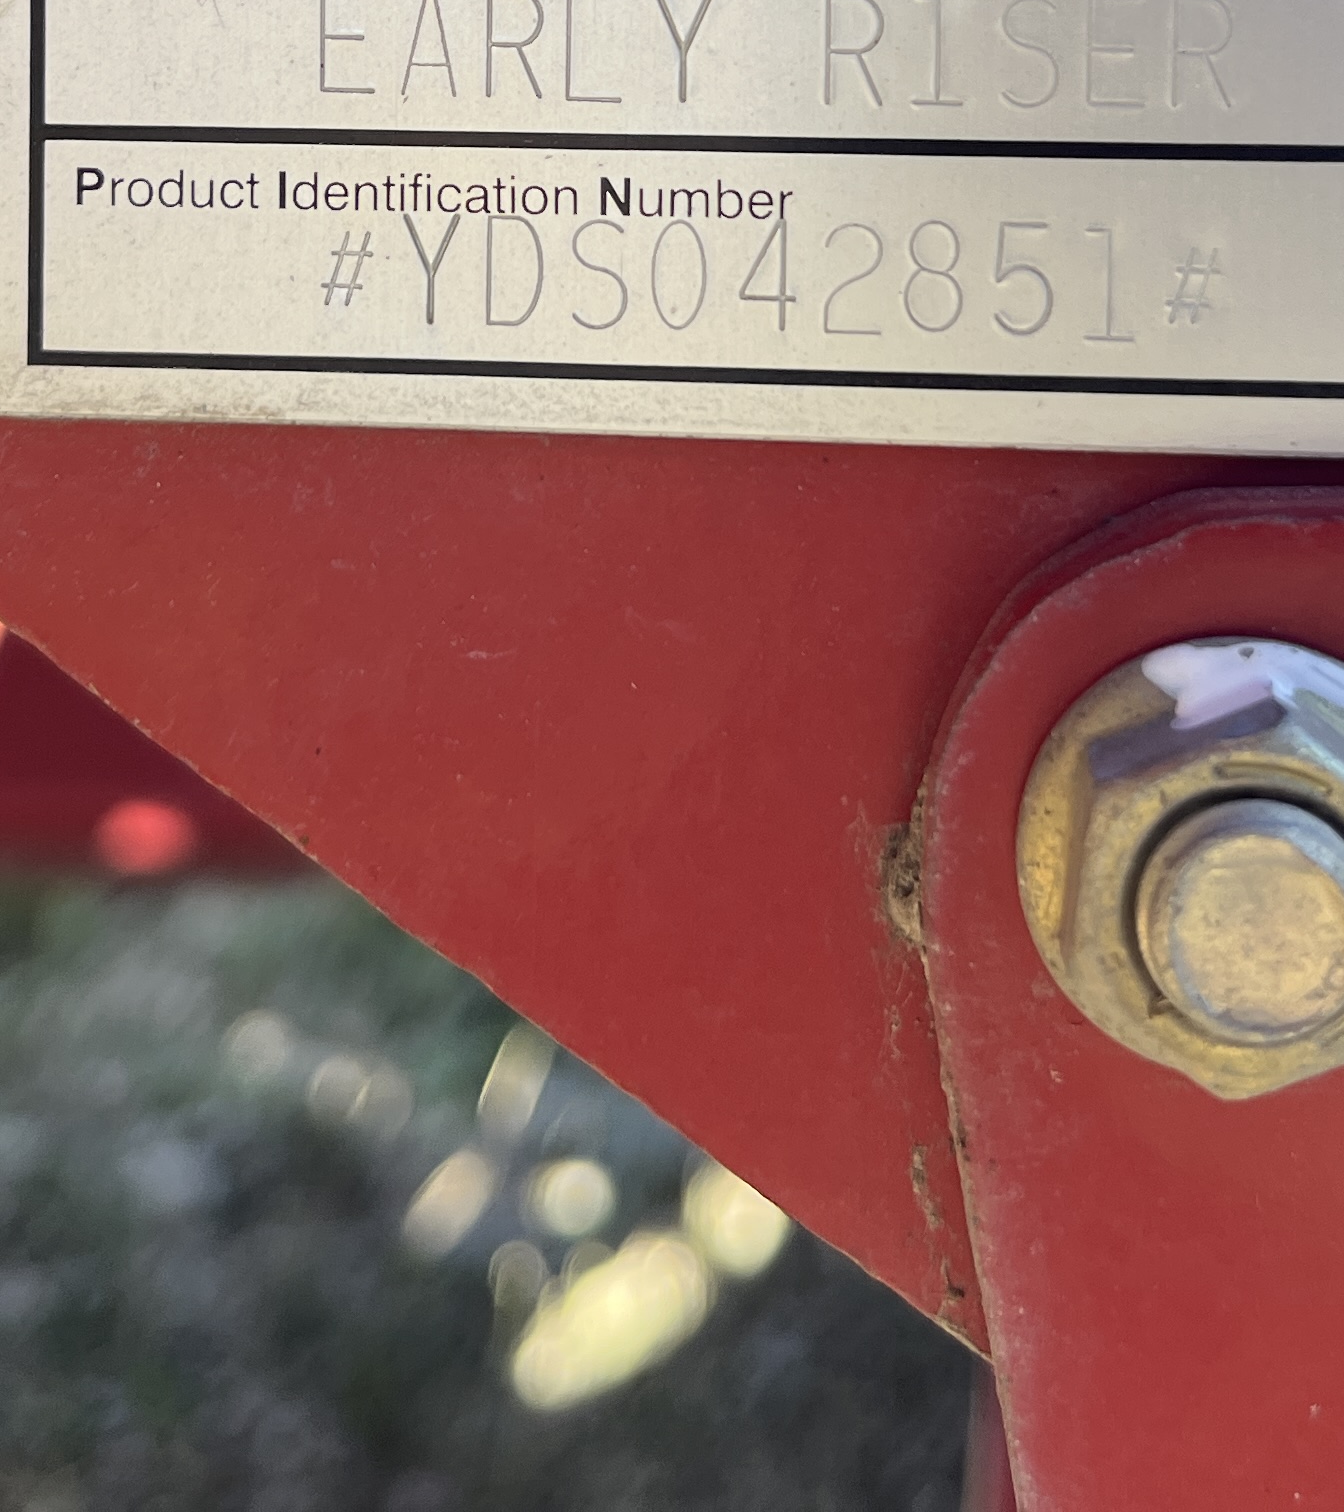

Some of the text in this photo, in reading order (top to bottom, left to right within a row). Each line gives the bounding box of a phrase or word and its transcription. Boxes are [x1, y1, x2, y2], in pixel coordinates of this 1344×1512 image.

[76, 166, 794, 220] Product Identification Number
[321, 213, 1223, 343] #YDS042851#
